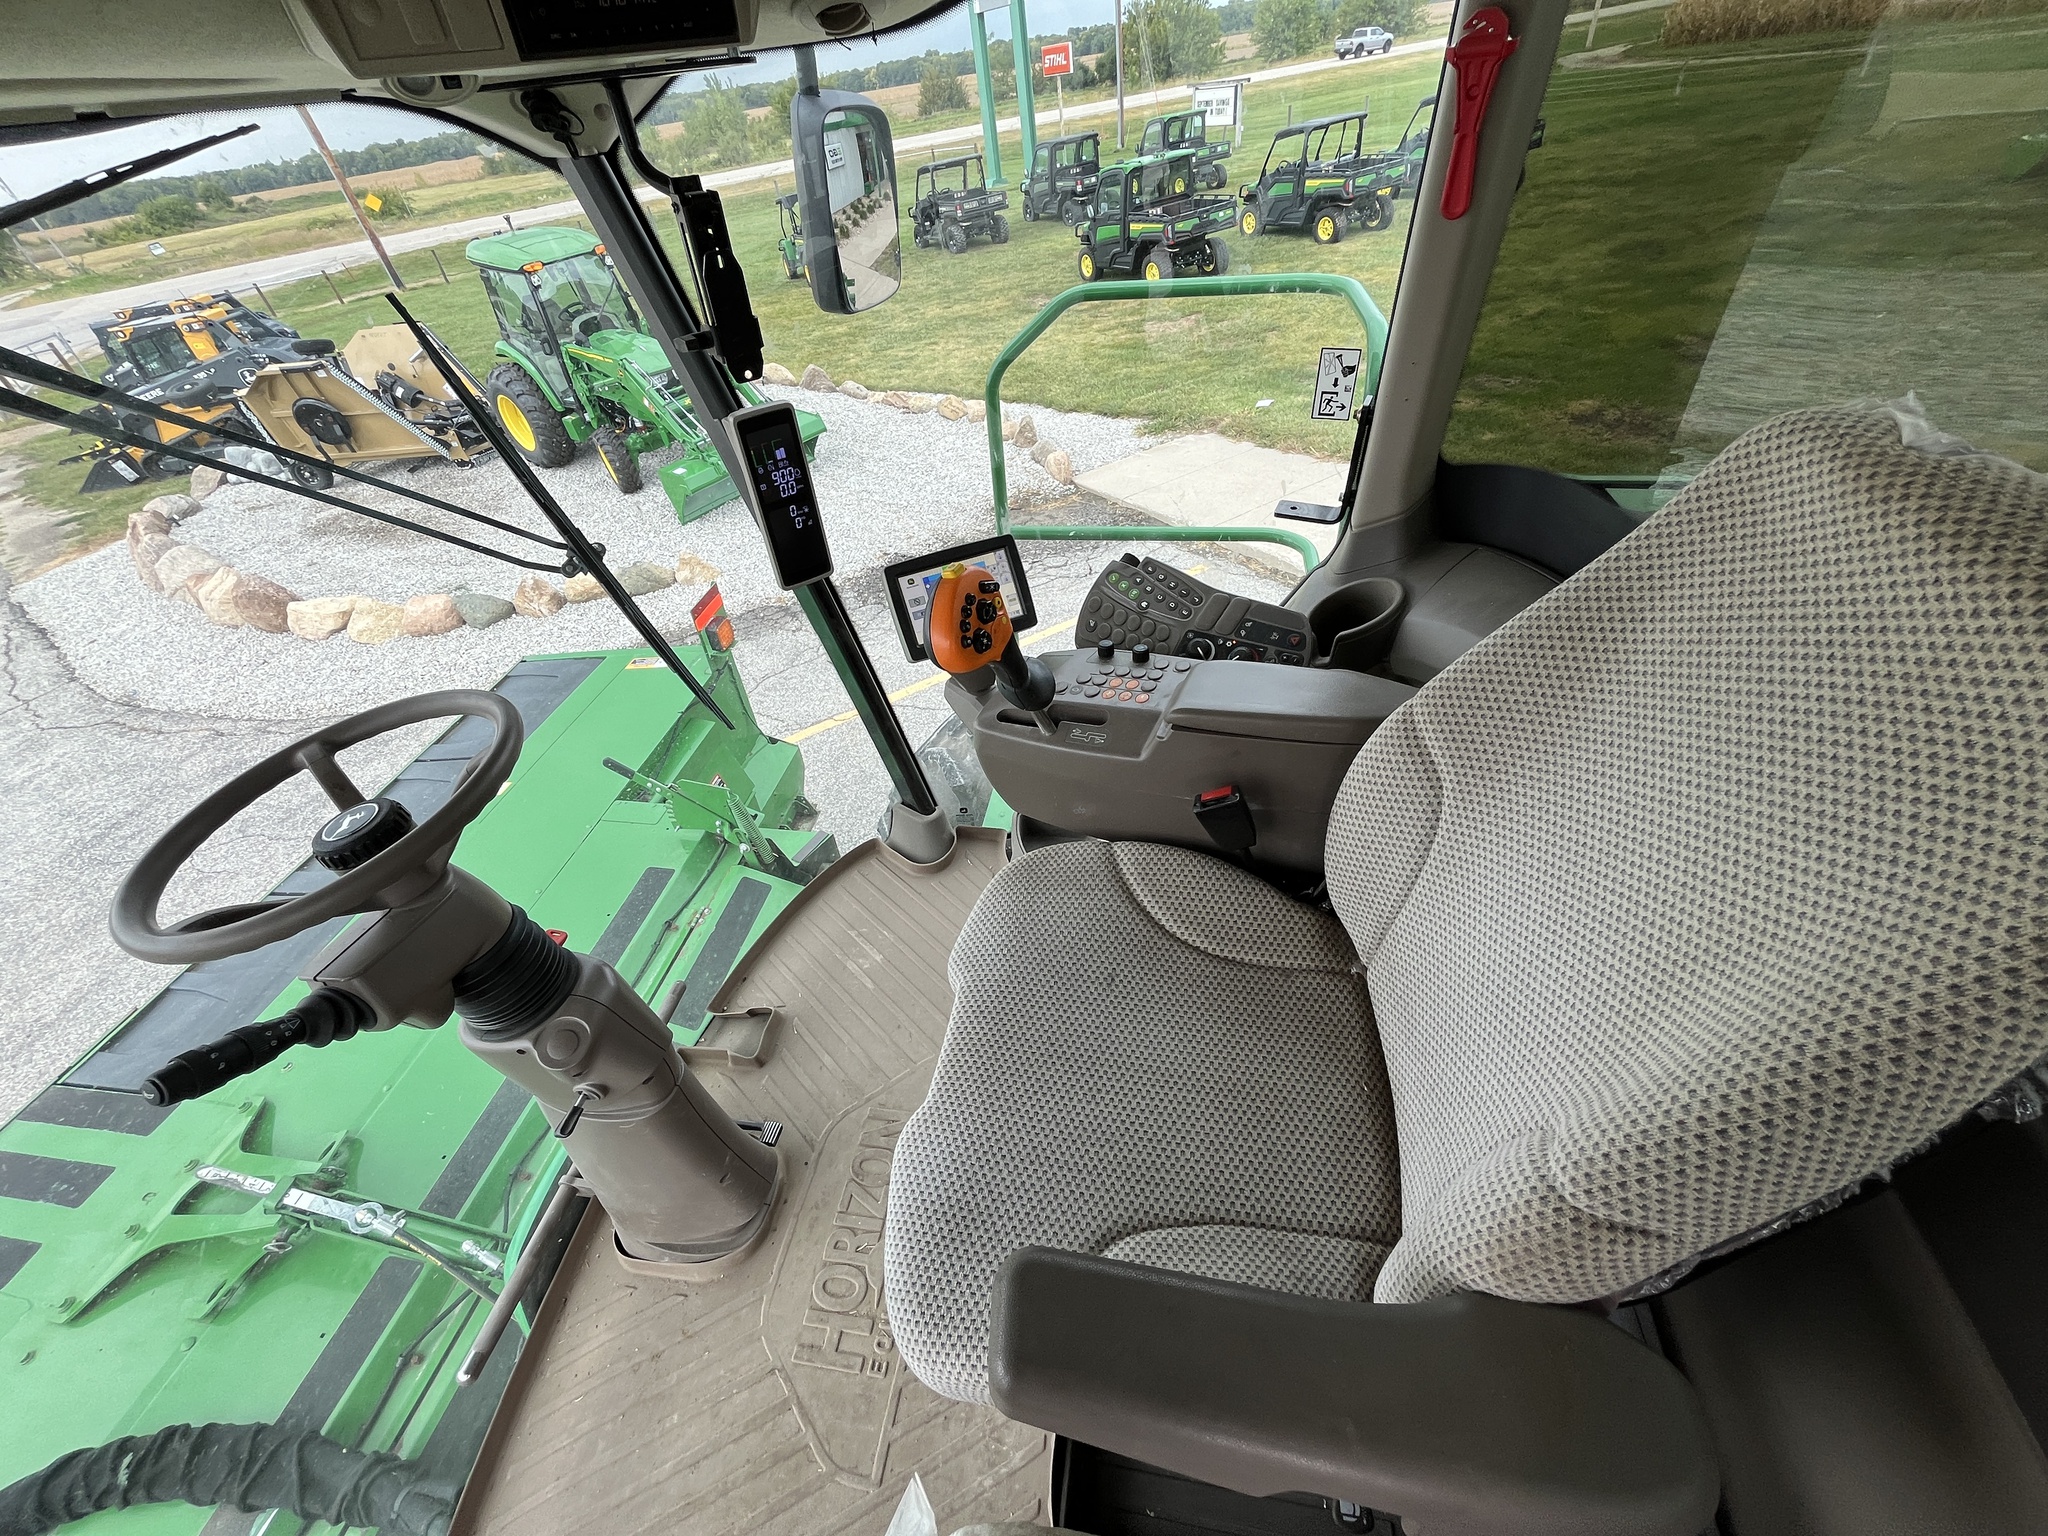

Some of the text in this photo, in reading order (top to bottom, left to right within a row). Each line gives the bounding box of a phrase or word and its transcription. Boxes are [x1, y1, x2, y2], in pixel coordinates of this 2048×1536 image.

[1044, 52, 1067, 68] STIHL
[772, 467, 795, 485] 900
[780, 481, 797, 497] 0.0
[791, 1106, 912, 1375] HORIZON
